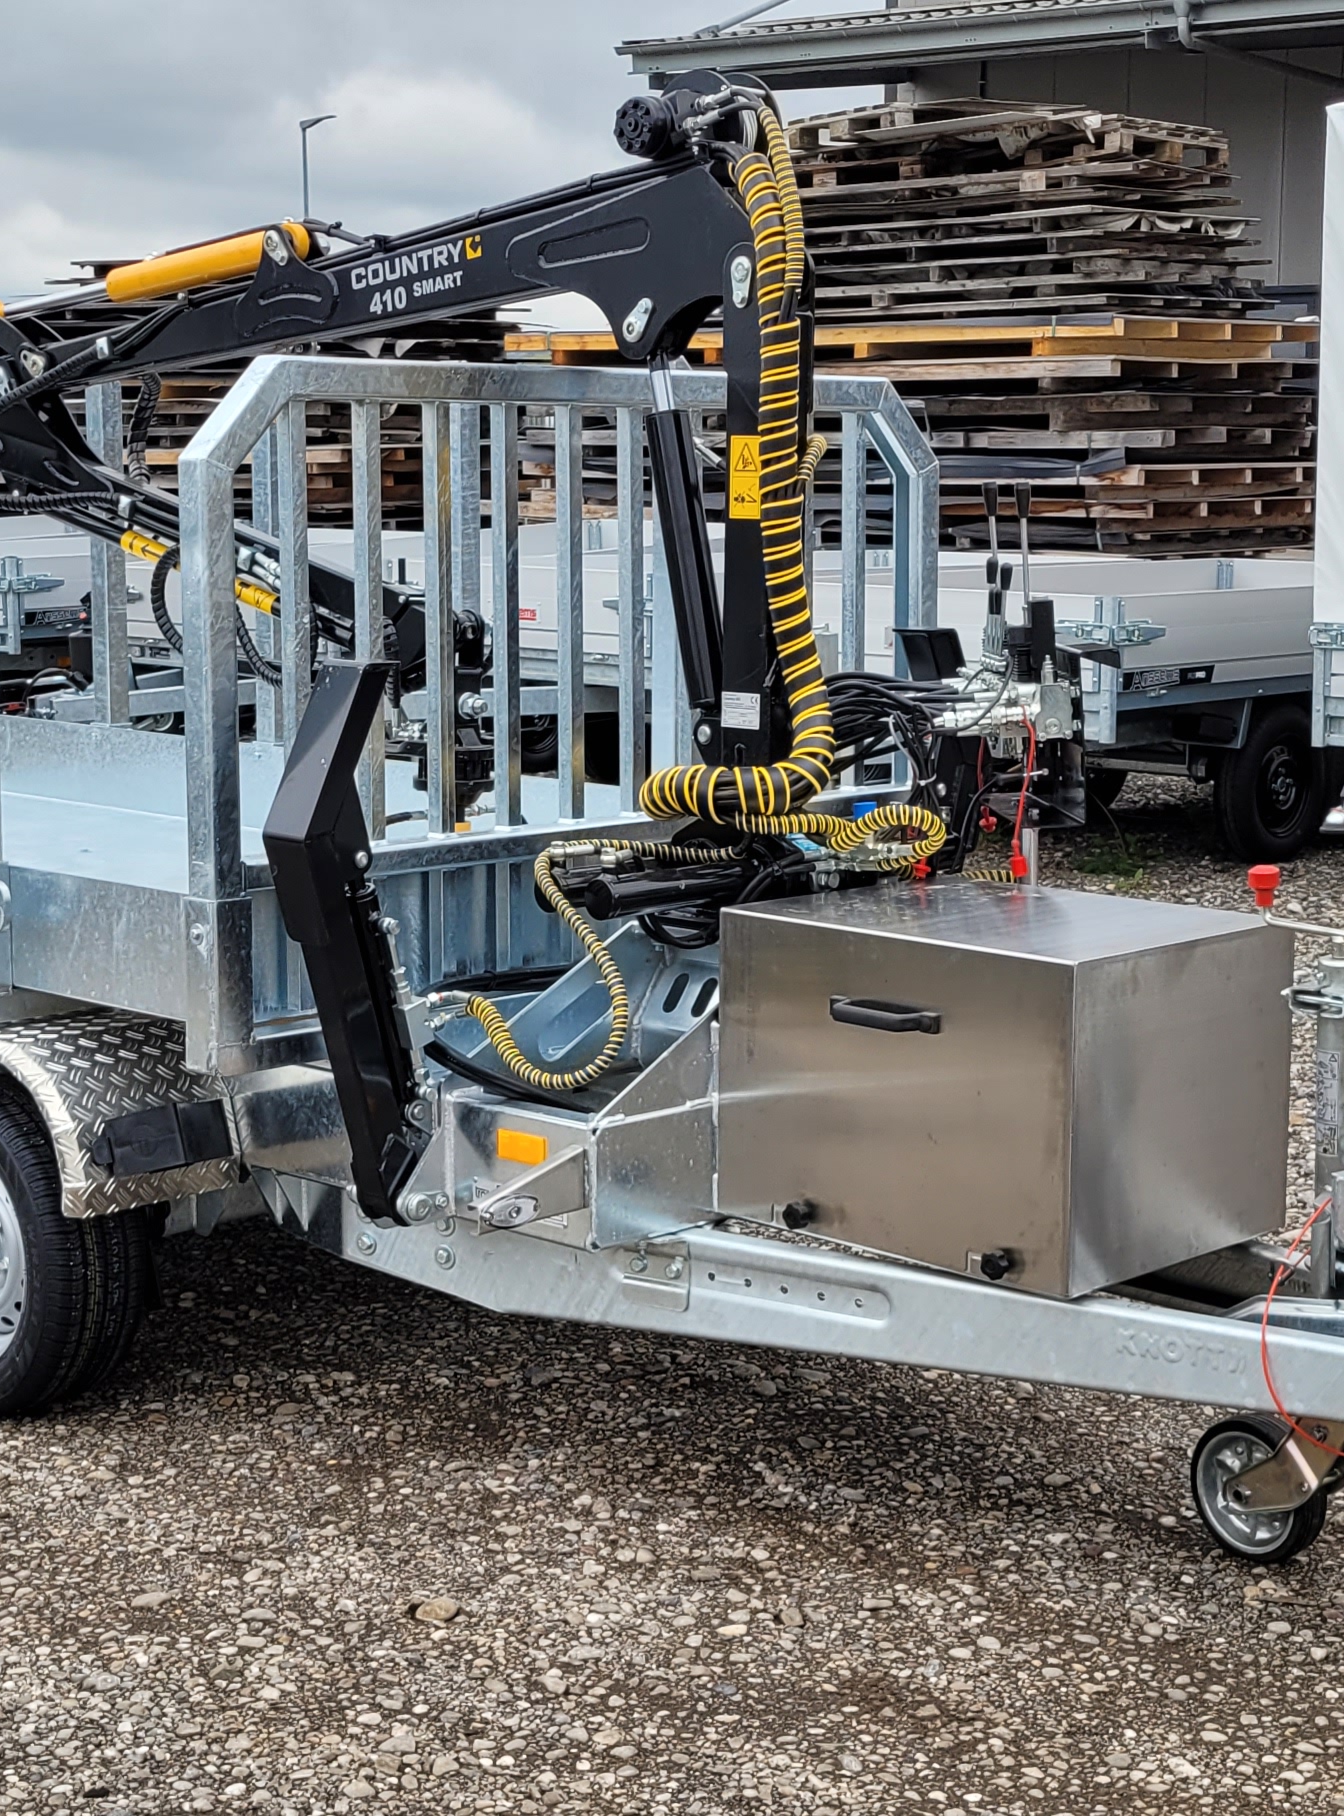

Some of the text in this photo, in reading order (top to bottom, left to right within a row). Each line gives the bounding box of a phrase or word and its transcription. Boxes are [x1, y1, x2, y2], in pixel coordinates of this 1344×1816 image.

[350, 239, 463, 290] COUNTRY
[369, 270, 463, 315] 410 SMART
